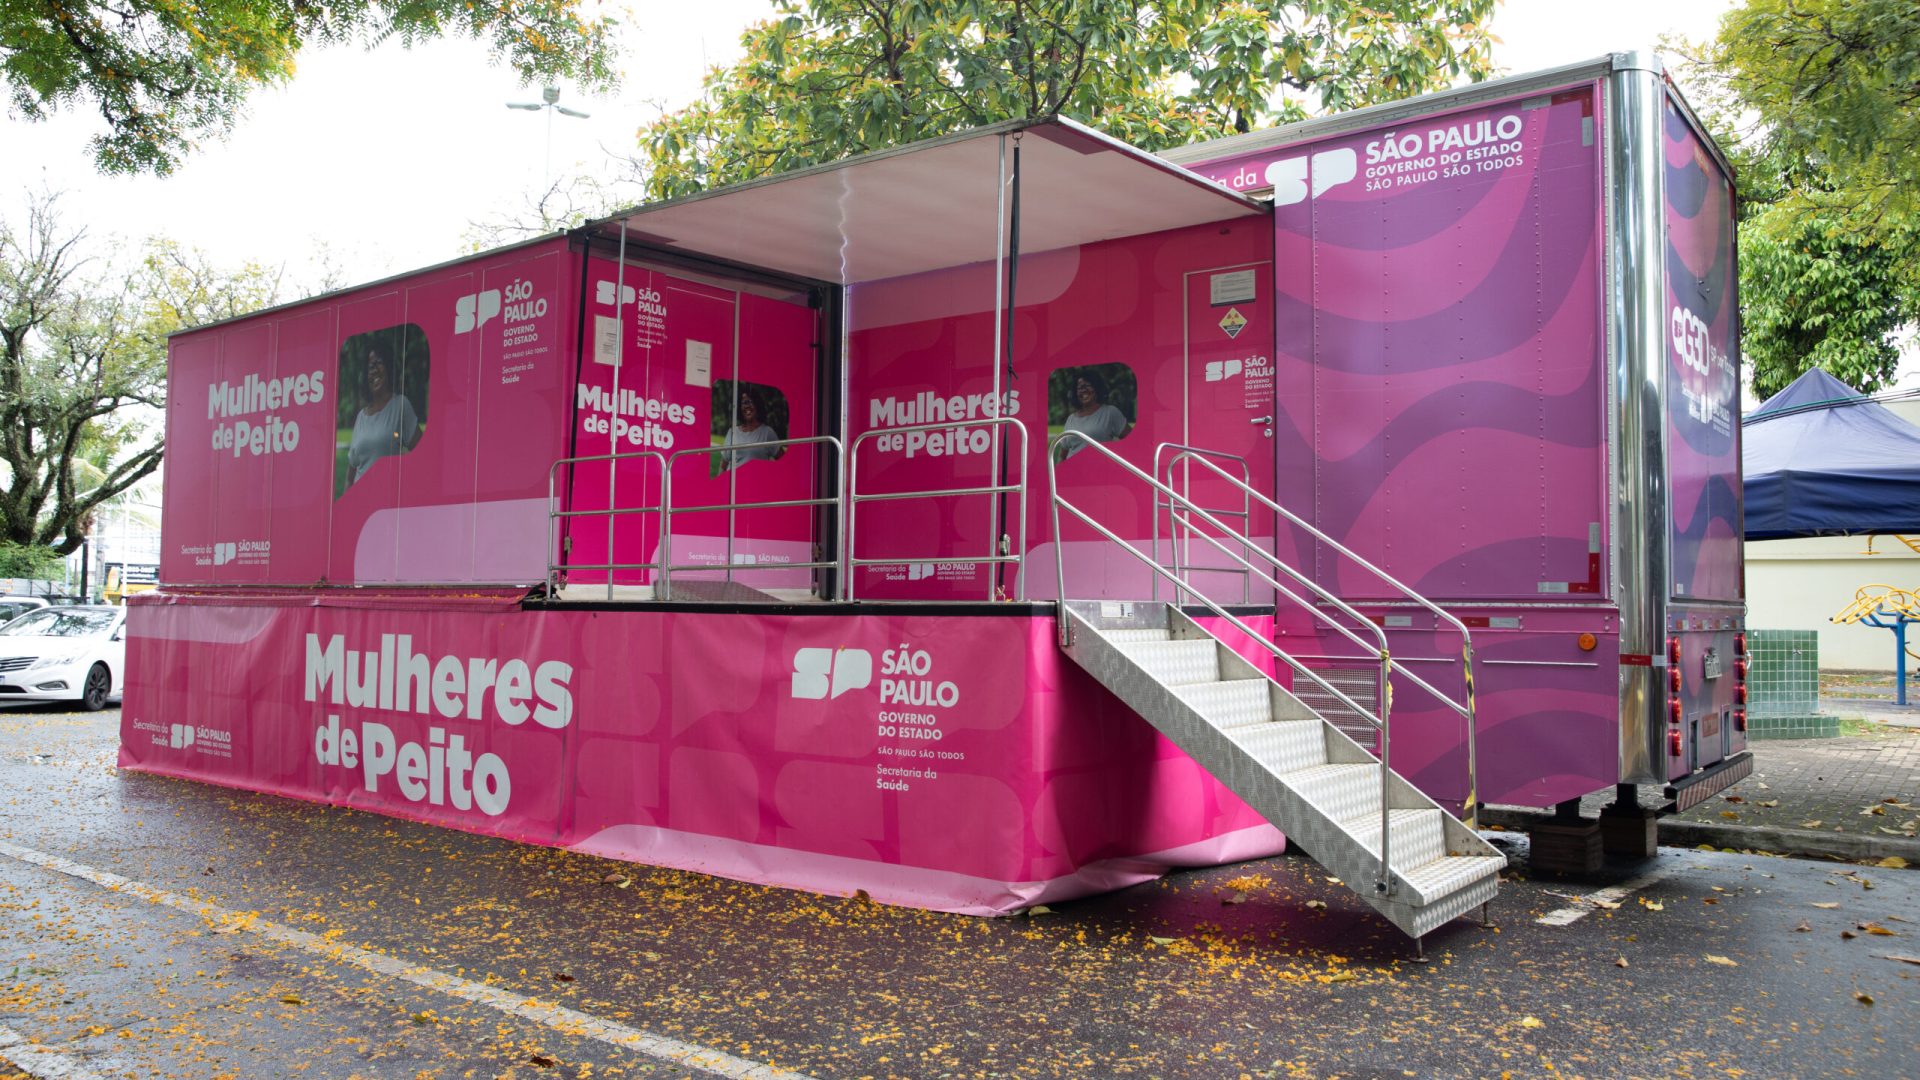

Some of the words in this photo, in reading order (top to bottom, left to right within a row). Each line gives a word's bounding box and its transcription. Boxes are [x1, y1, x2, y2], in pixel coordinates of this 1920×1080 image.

[1366, 131, 1423, 165] SÃO
[1428, 115, 1523, 153] PAULO
[1366, 156, 1437, 179] GOVERNO
[1440, 152, 1462, 166] DO
[1466, 141, 1523, 161] ESTADO
[1233, 168, 1257, 188] da
[1366, 176, 1392, 192] SÃO
[1397, 170, 1438, 187] PAULO
[1443, 164, 1471, 178] SÃO
[1477, 154, 1524, 174] TODOS
[504, 278, 533, 304] SÃO
[638, 288, 661, 303] SÃO
[503, 297, 548, 325] PAULO
[503, 323, 536, 338] GOVERNO
[503, 338, 513, 348] DO
[514, 333, 539, 346] ESTADO
[502, 363, 527, 374] Secretaria
[1245, 355, 1267, 368] SÃO
[502, 374, 520, 384] Saúde
[1245, 366, 1275, 378] PAULO
[208, 370, 325, 420] Mulheres
[578, 383, 696, 425] Mulheres
[870, 389, 1021, 428] Mulheres
[212, 422, 233, 451] de
[234, 415, 300, 458] Peito
[584, 413, 609, 434] de
[610, 416, 674, 450] Peito
[877, 434, 904, 453] de
[906, 426, 991, 458] Peito
[181, 544, 206, 555] Secretaria
[238, 539, 251, 552] SÃO
[251, 541, 270, 552] PAULO
[195, 556, 212, 566] Saúde
[868, 564, 897, 573] Secretaria
[953, 563, 976, 571] PAULO
[886, 572, 906, 581] Saúde
[880, 643, 932, 676] SÃO
[305, 633, 574, 729] Mulheres
[880, 679, 960, 708] PAULO
[133, 718, 160, 733] Secretaria
[878, 711, 936, 726] GOVERNO
[152, 734, 168, 746] Saúde
[197, 725, 209, 739] SÃO
[210, 729, 231, 743] PAULO
[878, 725, 896, 737] DO
[899, 727, 943, 740] ESTADO
[878, 745, 893, 756] SÃO
[895, 748, 917, 757] PAULO
[919, 748, 935, 759] SÃO
[937, 751, 965, 760] TODOS
[315, 714, 358, 769] de
[362, 721, 511, 816] Peito
[877, 764, 922, 778] Secretaria
[924, 767, 937, 779] da
[877, 778, 909, 791] Saúde
